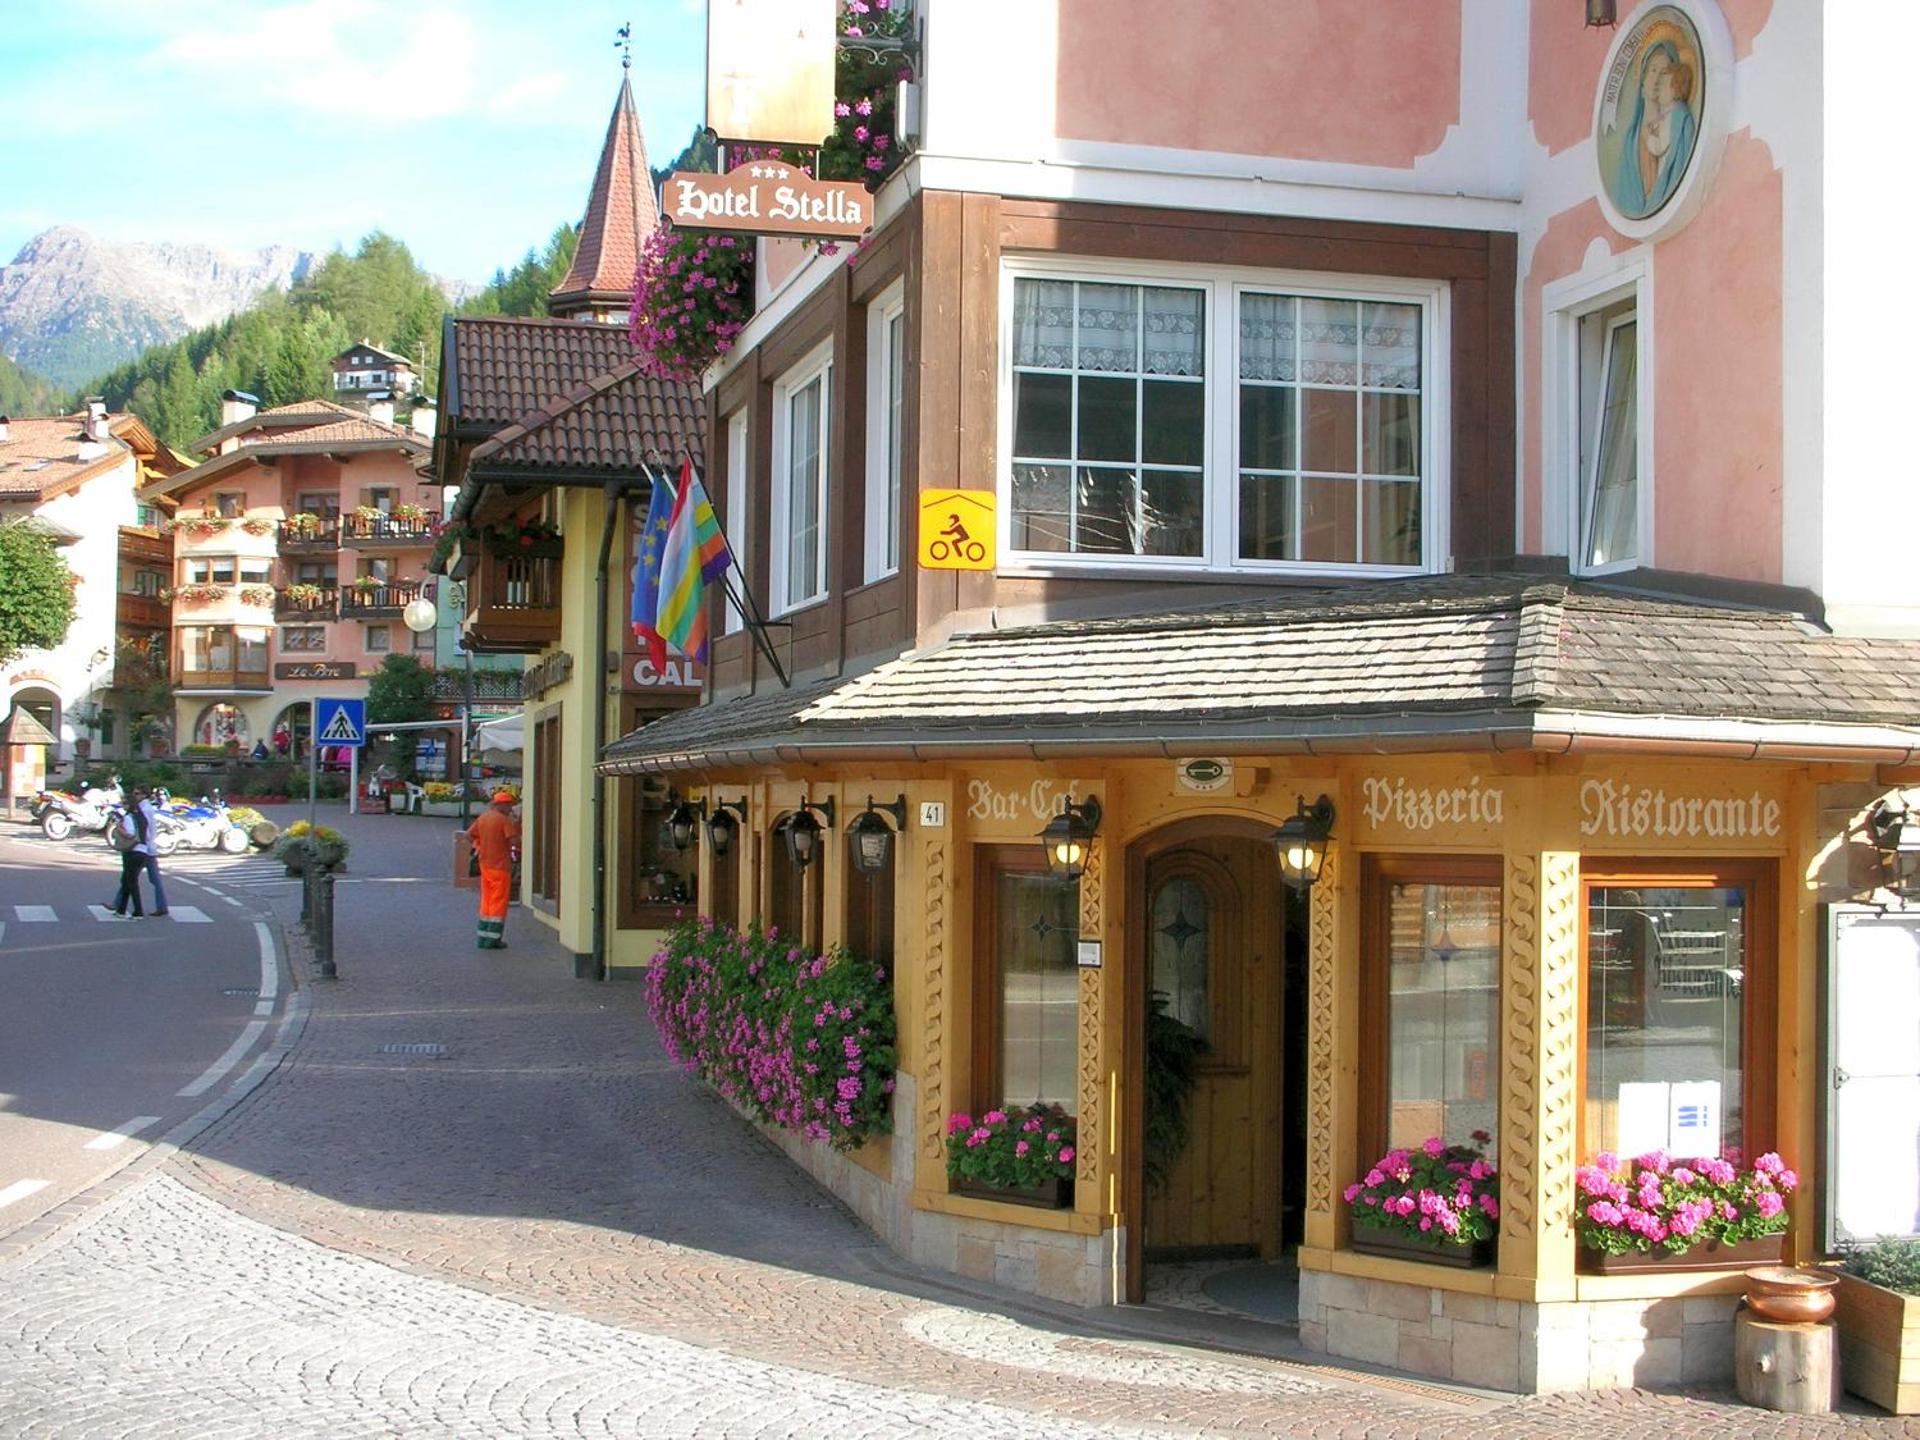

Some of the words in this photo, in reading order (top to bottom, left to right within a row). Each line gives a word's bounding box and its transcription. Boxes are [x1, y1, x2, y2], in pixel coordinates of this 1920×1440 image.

[676, 180, 760, 220] Hotel
[768, 186, 862, 224] Stella
[633, 659, 703, 687] CAL
[926, 805, 939, 823] 41
[1363, 775, 1504, 830] Pizzeria
[1580, 779, 1782, 837] Ristorante
